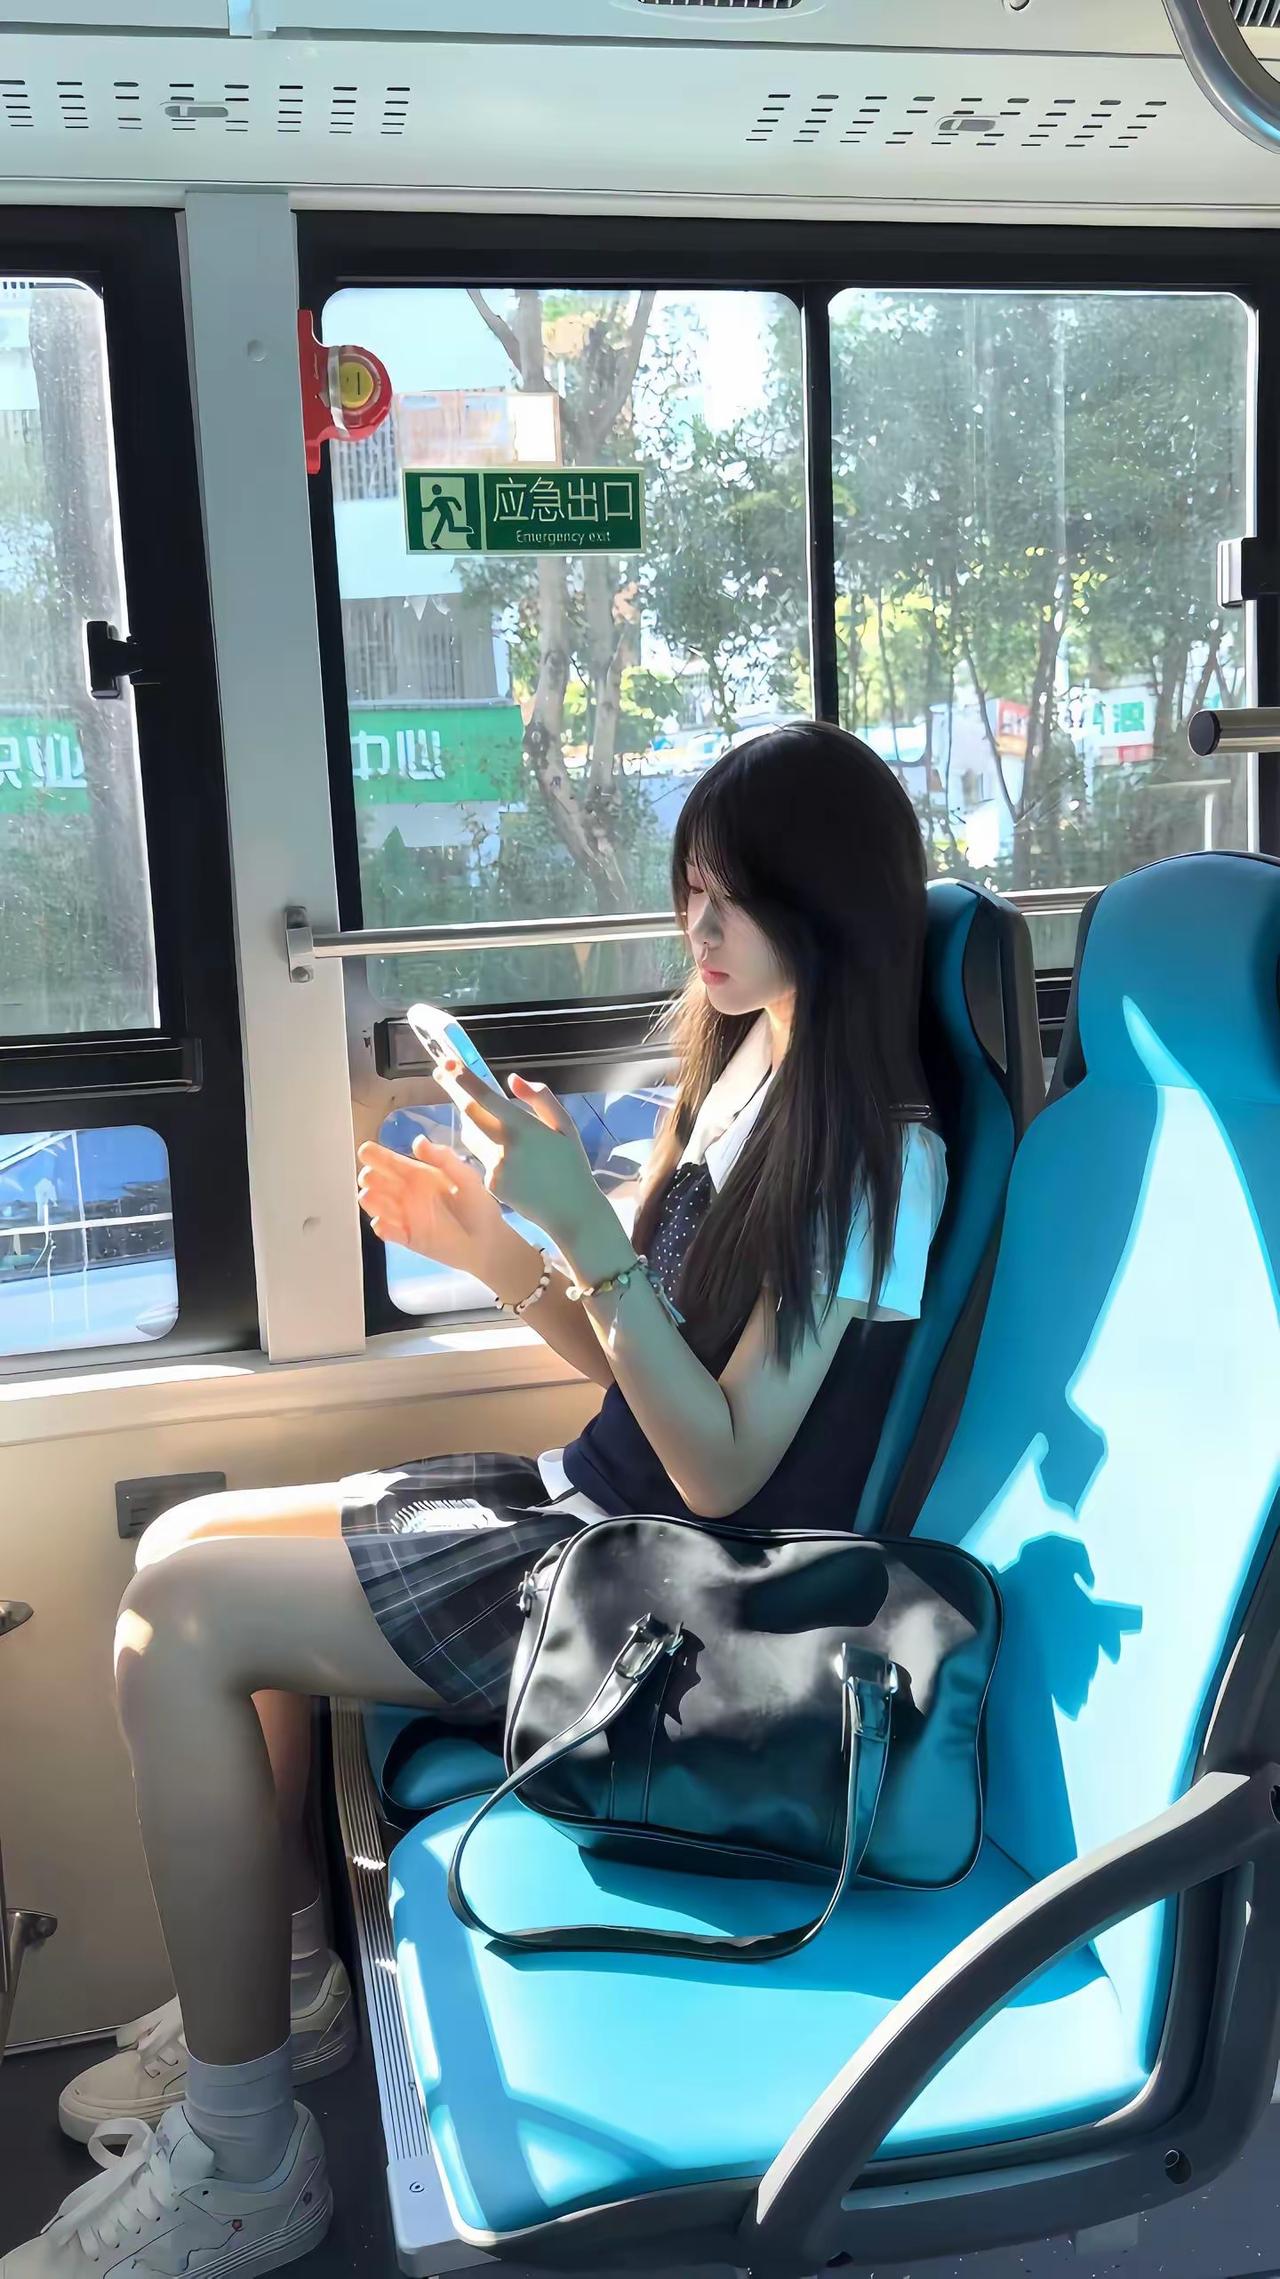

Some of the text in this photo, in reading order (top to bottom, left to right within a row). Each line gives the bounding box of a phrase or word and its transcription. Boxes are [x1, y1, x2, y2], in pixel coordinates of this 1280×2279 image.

[493, 477, 633, 522] 应急出口
[516, 530, 611, 546] Emergency exit
